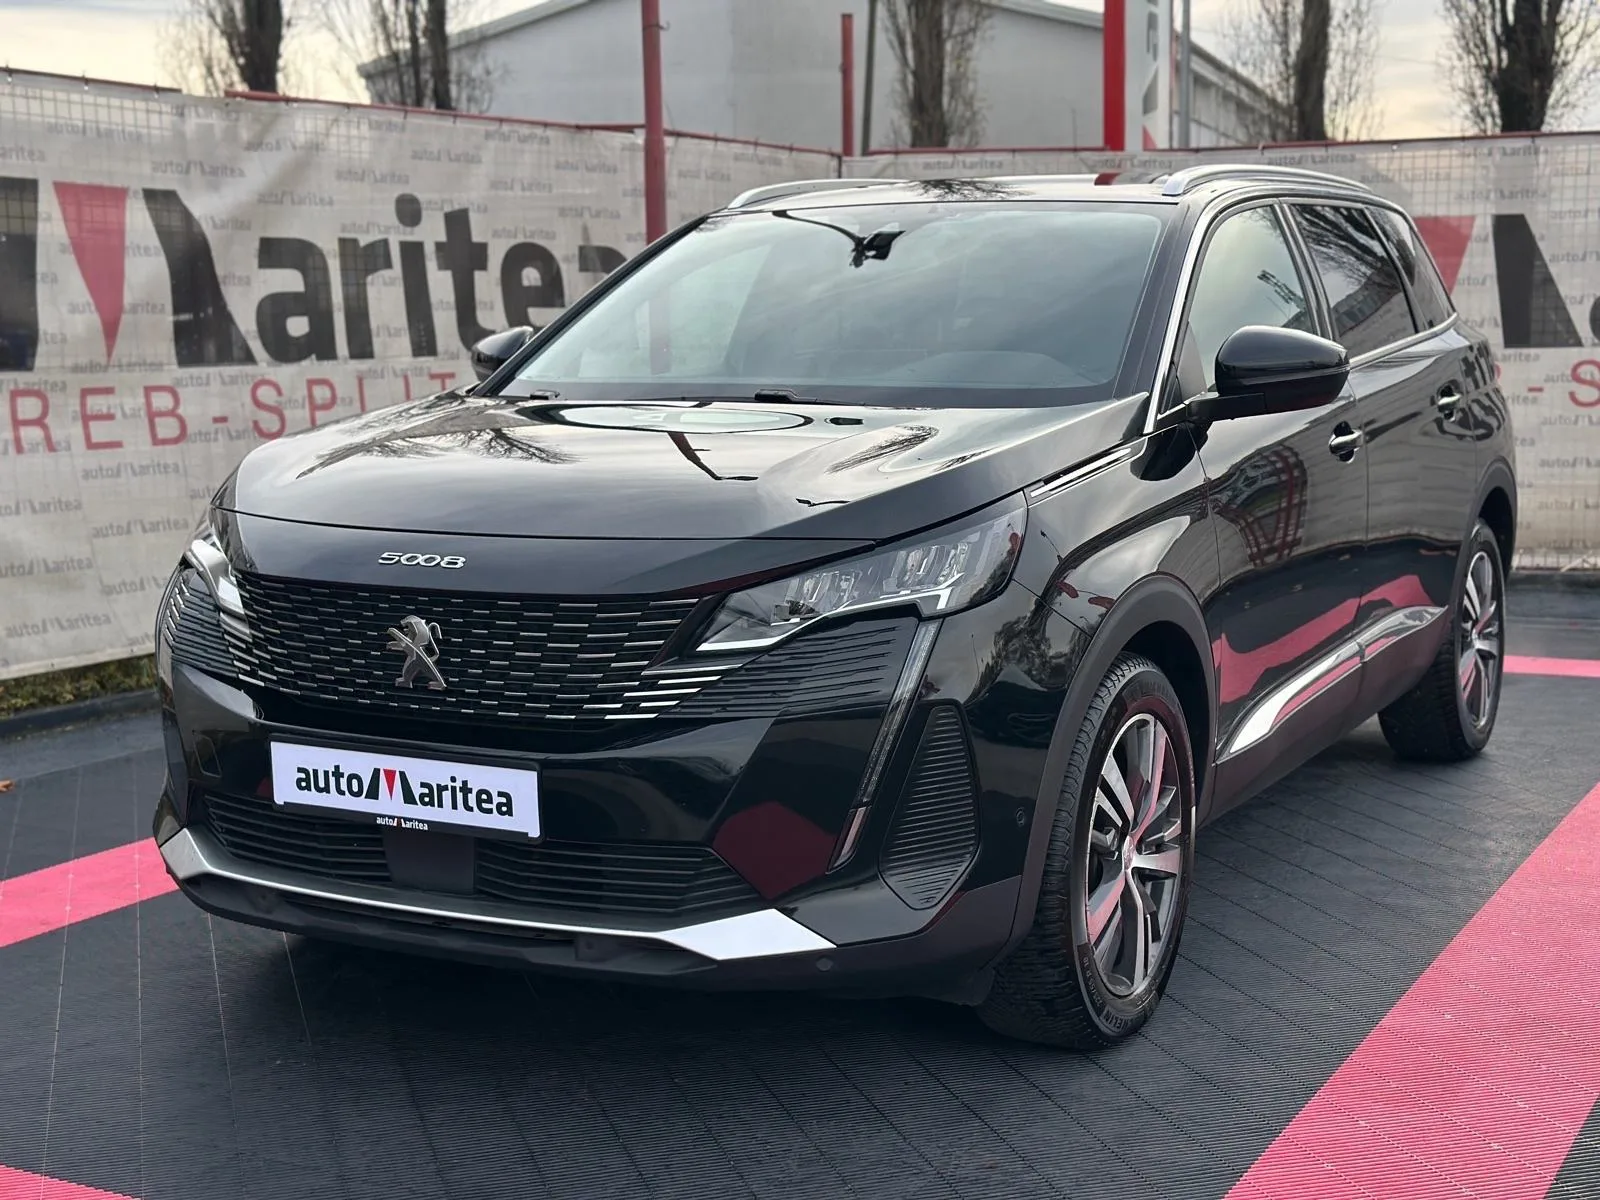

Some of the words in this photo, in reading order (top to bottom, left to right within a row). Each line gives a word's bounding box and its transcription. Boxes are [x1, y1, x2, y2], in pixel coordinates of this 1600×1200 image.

[81, 460, 181, 480] autoMaritea
[92, 517, 190, 539] autoMaritea
[378, 551, 466, 569] 5008
[5, 612, 113, 640] autoMaritea
[295, 764, 514, 817] autoMaritea
